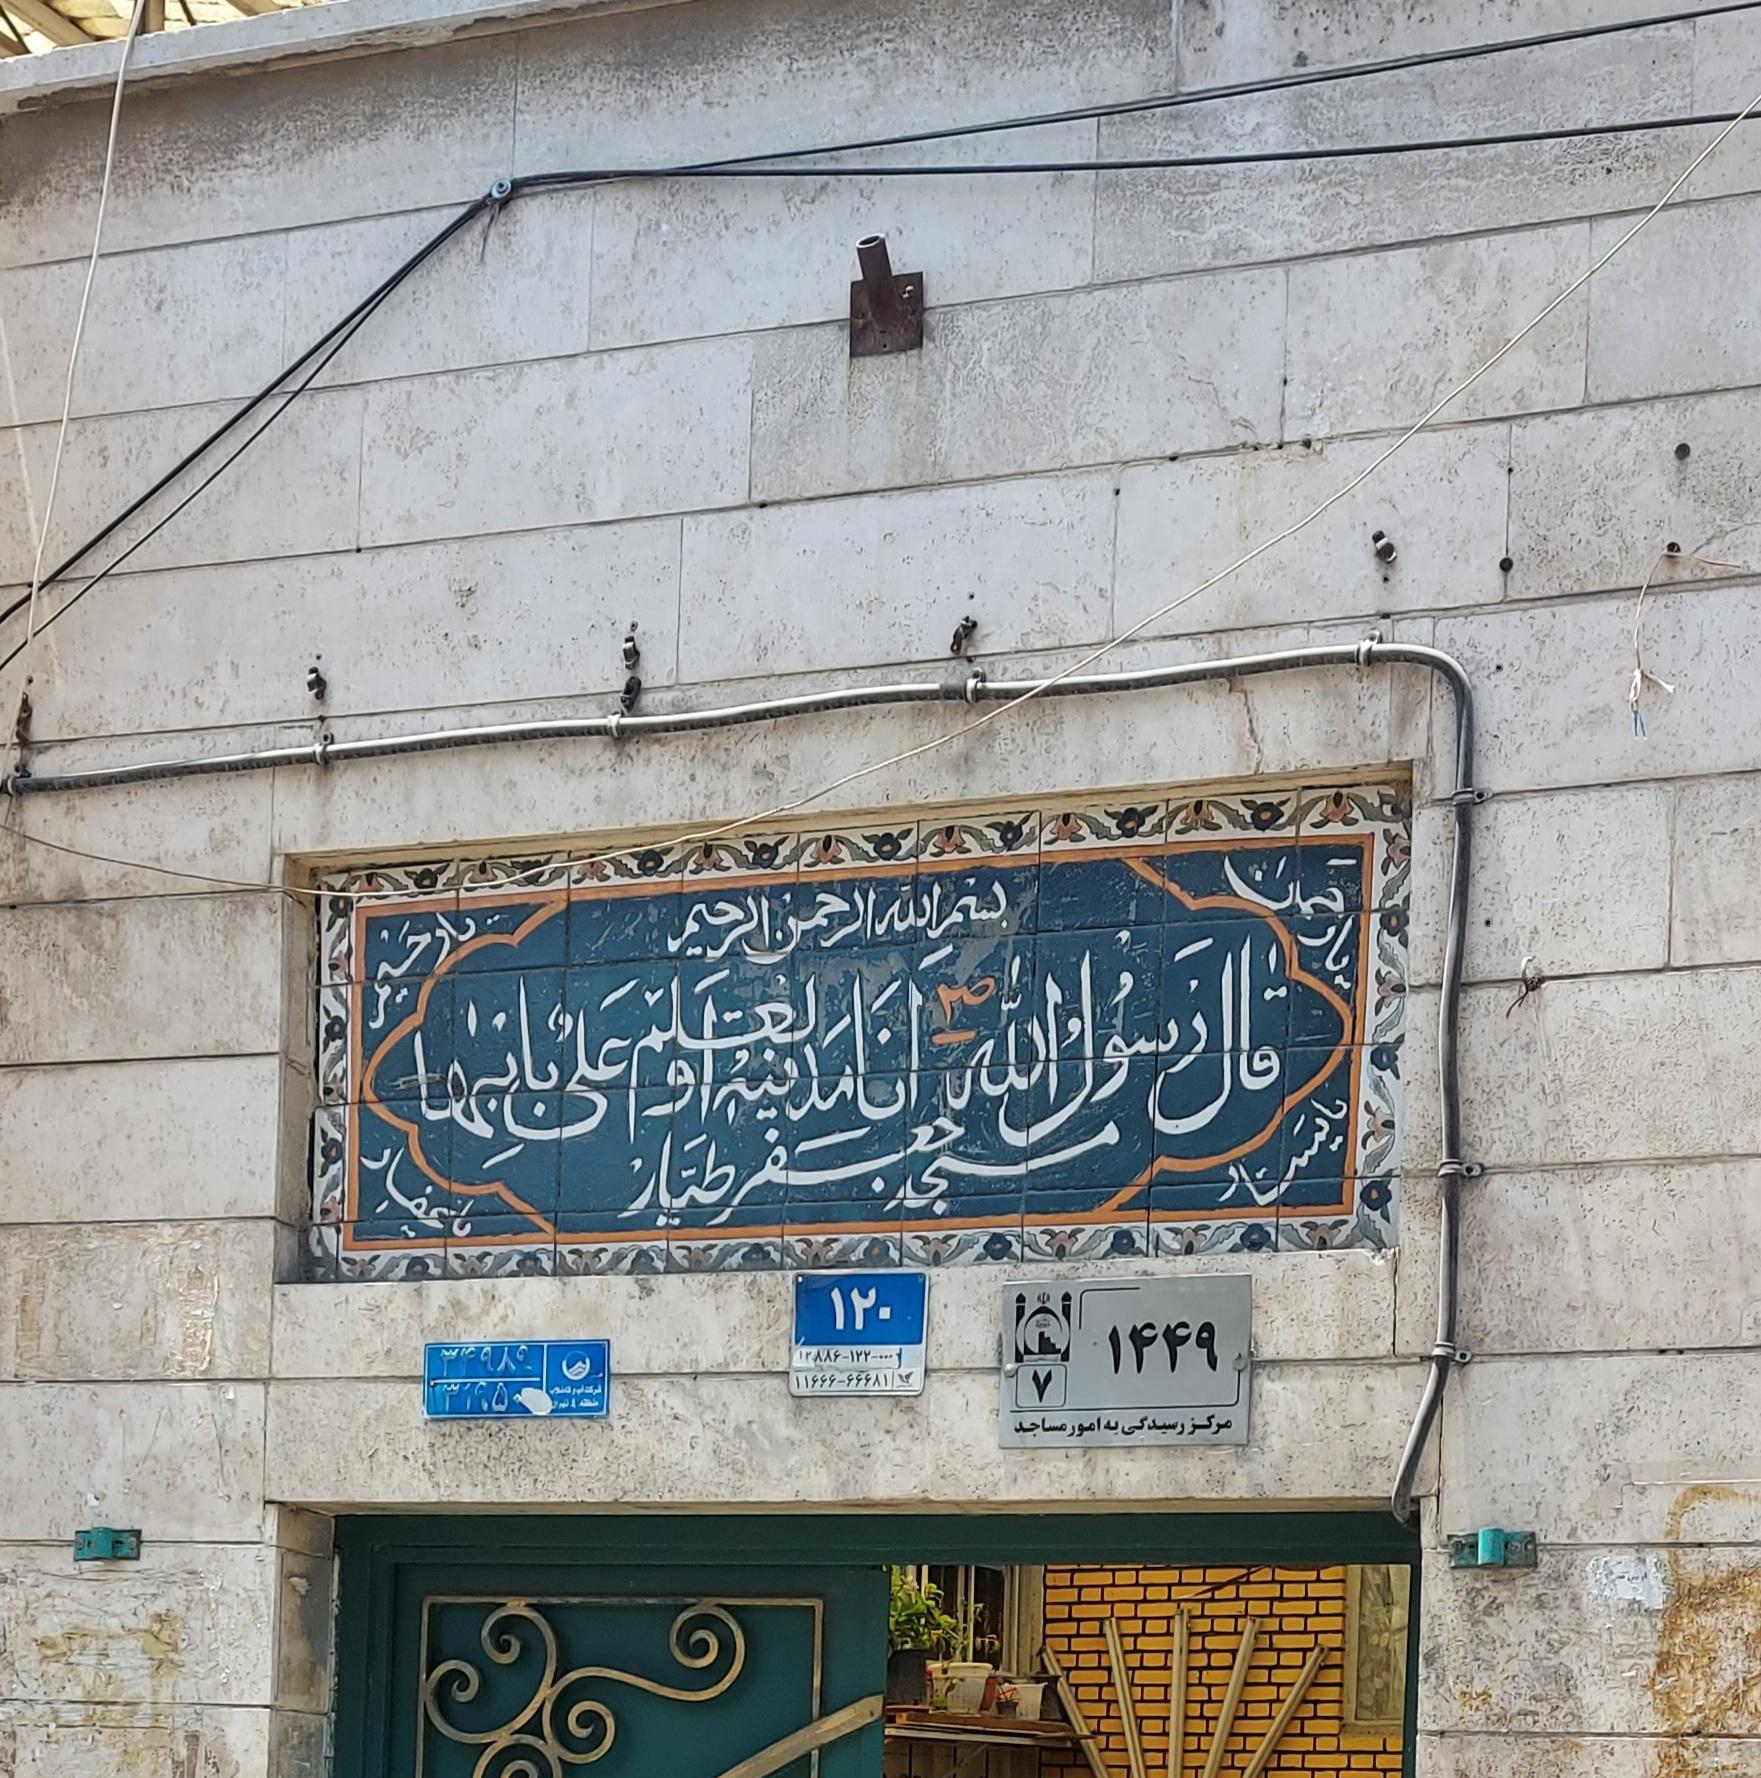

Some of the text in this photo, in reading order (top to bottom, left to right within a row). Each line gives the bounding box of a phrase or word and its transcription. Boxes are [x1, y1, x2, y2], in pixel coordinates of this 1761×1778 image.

[742, 887, 876, 965] الرحمن
[875, 880, 941, 937] الله
[927, 880, 1007, 938] بسم
[617, 1116, 1120, 1227] مسجد جعفر طیار
[831, 1286, 892, 1331] ۱۲۰
[1108, 1321, 1219, 1376] ۱۴۴۹
[1031, 1368, 1054, 1403] ۷
[1014, 1414, 1233, 1438] مرکز رسیدگی به امور مساجد
